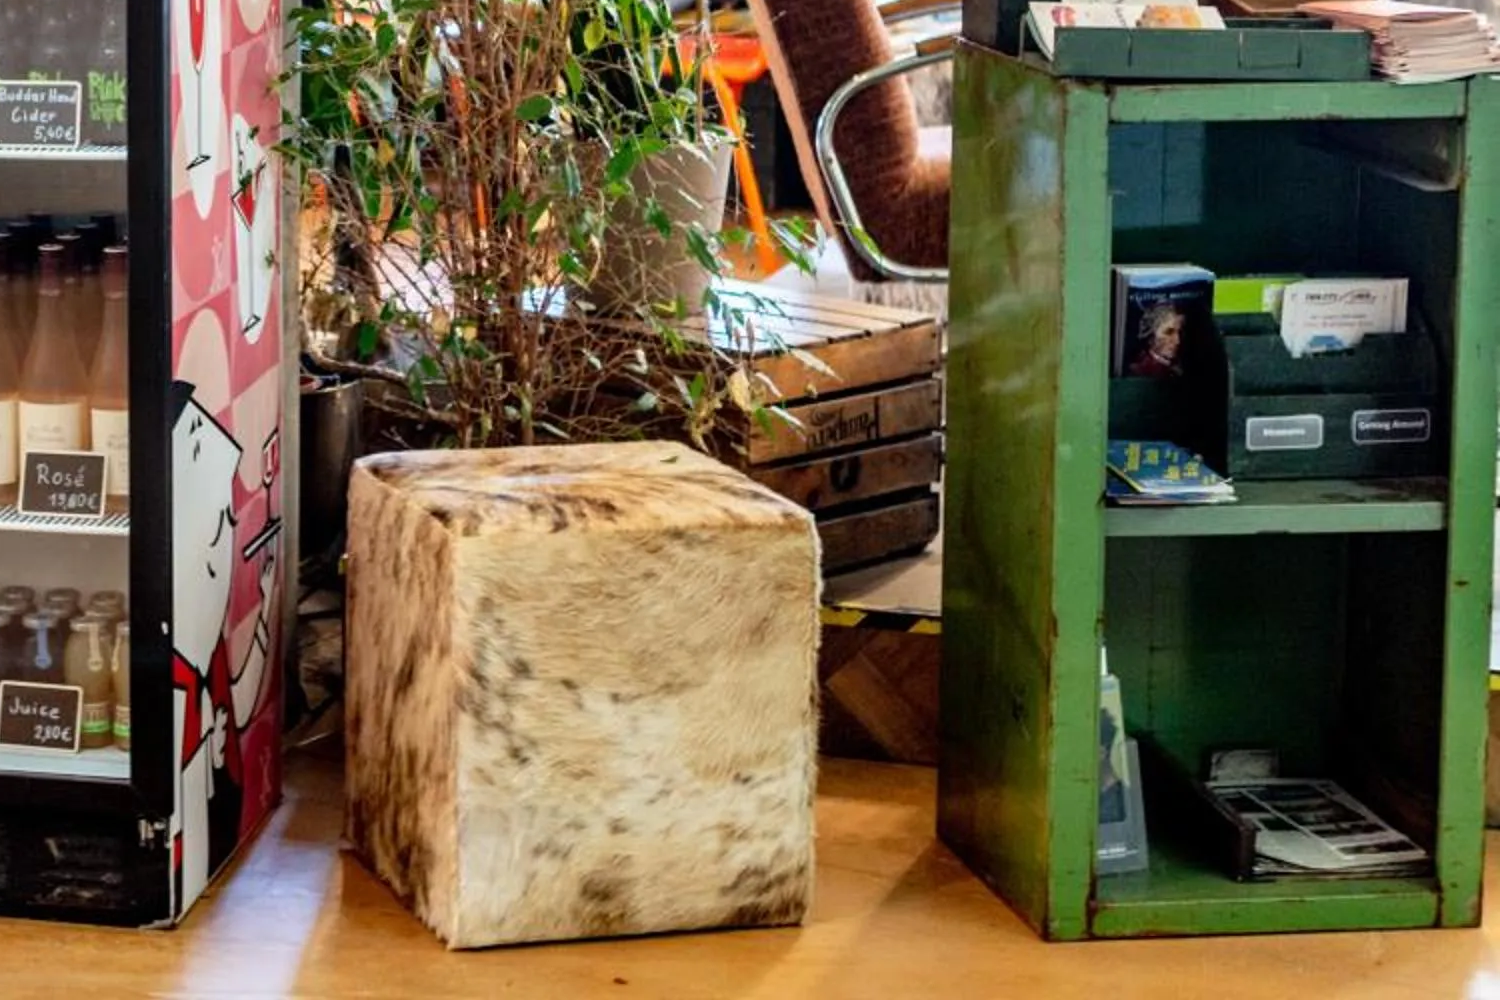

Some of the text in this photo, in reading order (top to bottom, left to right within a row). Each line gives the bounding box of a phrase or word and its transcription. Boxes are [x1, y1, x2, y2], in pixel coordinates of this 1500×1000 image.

[11, 106, 57, 124] Cider
[36, 463, 85, 488] Rosé
[9, 696, 61, 719] Juice
